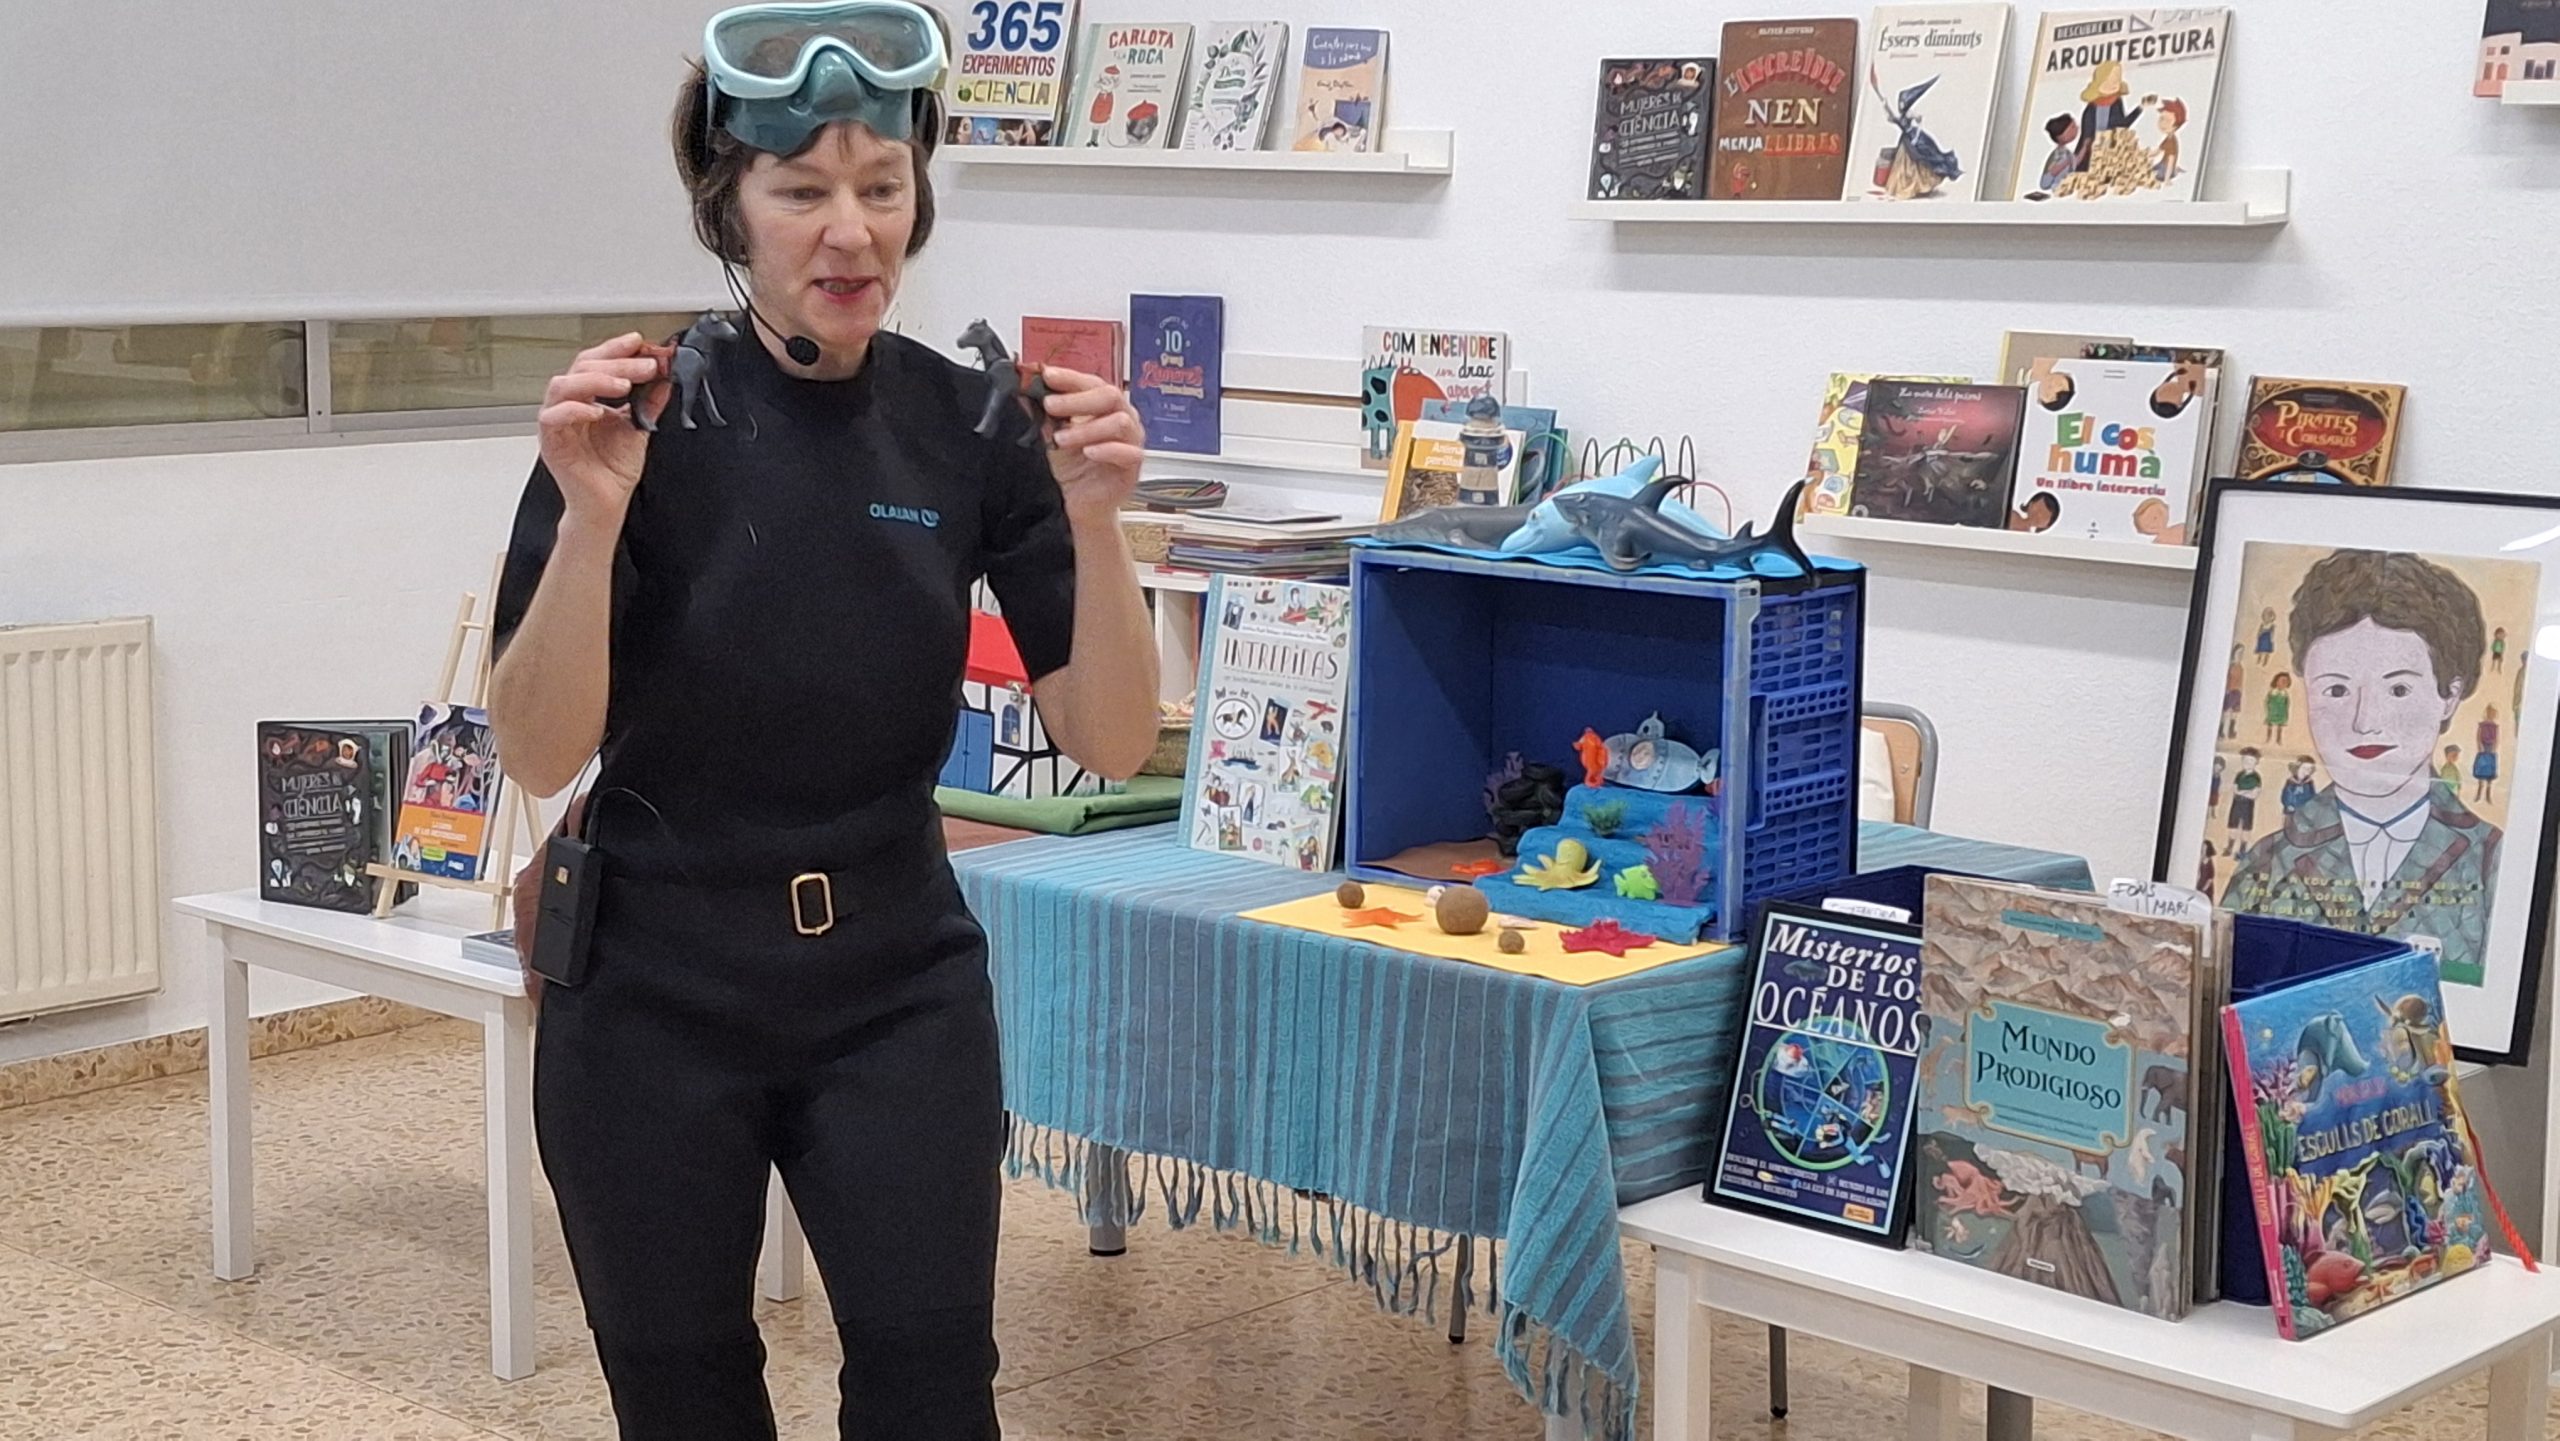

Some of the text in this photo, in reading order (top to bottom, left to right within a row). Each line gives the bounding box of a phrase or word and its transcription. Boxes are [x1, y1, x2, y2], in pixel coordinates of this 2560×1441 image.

[967, 1, 1065, 52] 365
[1109, 29, 1174, 49] CARLOTA
[1127, 48, 1164, 65] ROCA
[2046, 27, 2216, 73] ARQUITECTURA
[962, 54, 1056, 76] EXPERIMENTOS
[973, 80, 1050, 105] CIENCIA
[1744, 98, 1822, 125] NEN
[1164, 329, 1183, 354] 10
[1383, 331, 1498, 360] COM ENCENDRE
[1458, 356, 1495, 378] drac
[2057, 411, 2157, 451] El cos
[1432, 442, 1466, 457] Anima
[2047, 444, 2162, 480] humà
[2036, 477, 2167, 497] Un llibre interactiu
[2112, 882, 2156, 898] FONS
[2153, 896, 2196, 916] MARÍ
[1767, 922, 1918, 977] Misterios
[1826, 964, 1867, 993] DE
[1756, 980, 1924, 1053] OCÉANOS
[2002, 1021, 2096, 1067] MUNDO
[1976, 1051, 2122, 1110] PRODIGIOSO
[2299, 1100, 2436, 1163] ESCULLS DE CORALL
